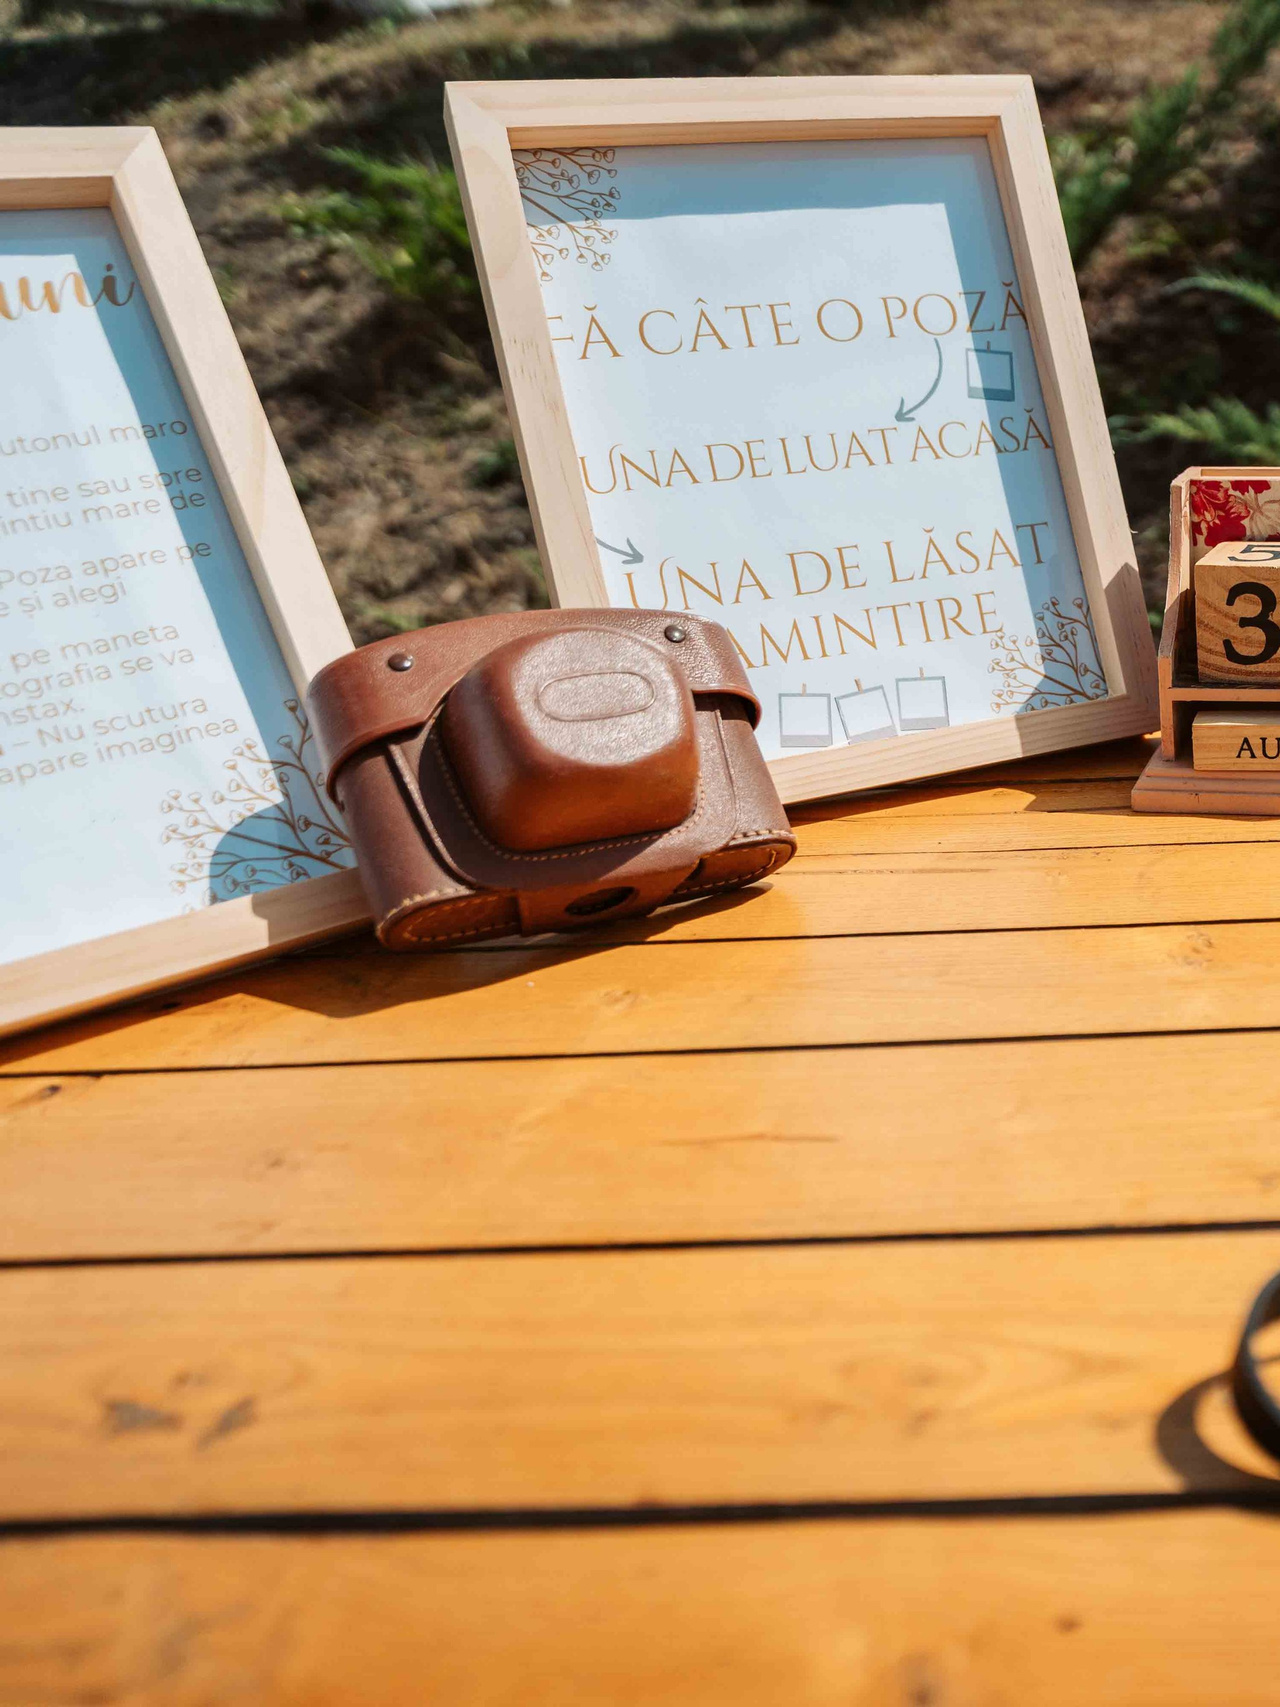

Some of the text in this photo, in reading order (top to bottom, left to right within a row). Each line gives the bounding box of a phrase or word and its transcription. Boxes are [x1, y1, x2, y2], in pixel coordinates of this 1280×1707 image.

[638, 296, 801, 356] CÂTE
[816, 298, 864, 343] O
[880, 281, 1030, 339] POZĂ
[110, 418, 188, 444] maro
[579, 408, 1054, 494] UNA DE LUAT ACASĂ
[7, 466, 203, 508] tine sau spre
[82, 497, 161, 524] mare
[169, 489, 207, 512] de
[0, 541, 213, 590] Poza apare pe
[622, 521, 1049, 611] UNA DE LĂSAT
[52, 579, 127, 608] alegi
[1, 646, 195, 699] ografia se va
[10, 623, 180, 674] pe maneta
[37, 724, 86, 748] Nu
[93, 697, 209, 736] scutura
[95, 717, 240, 763] imaginea
